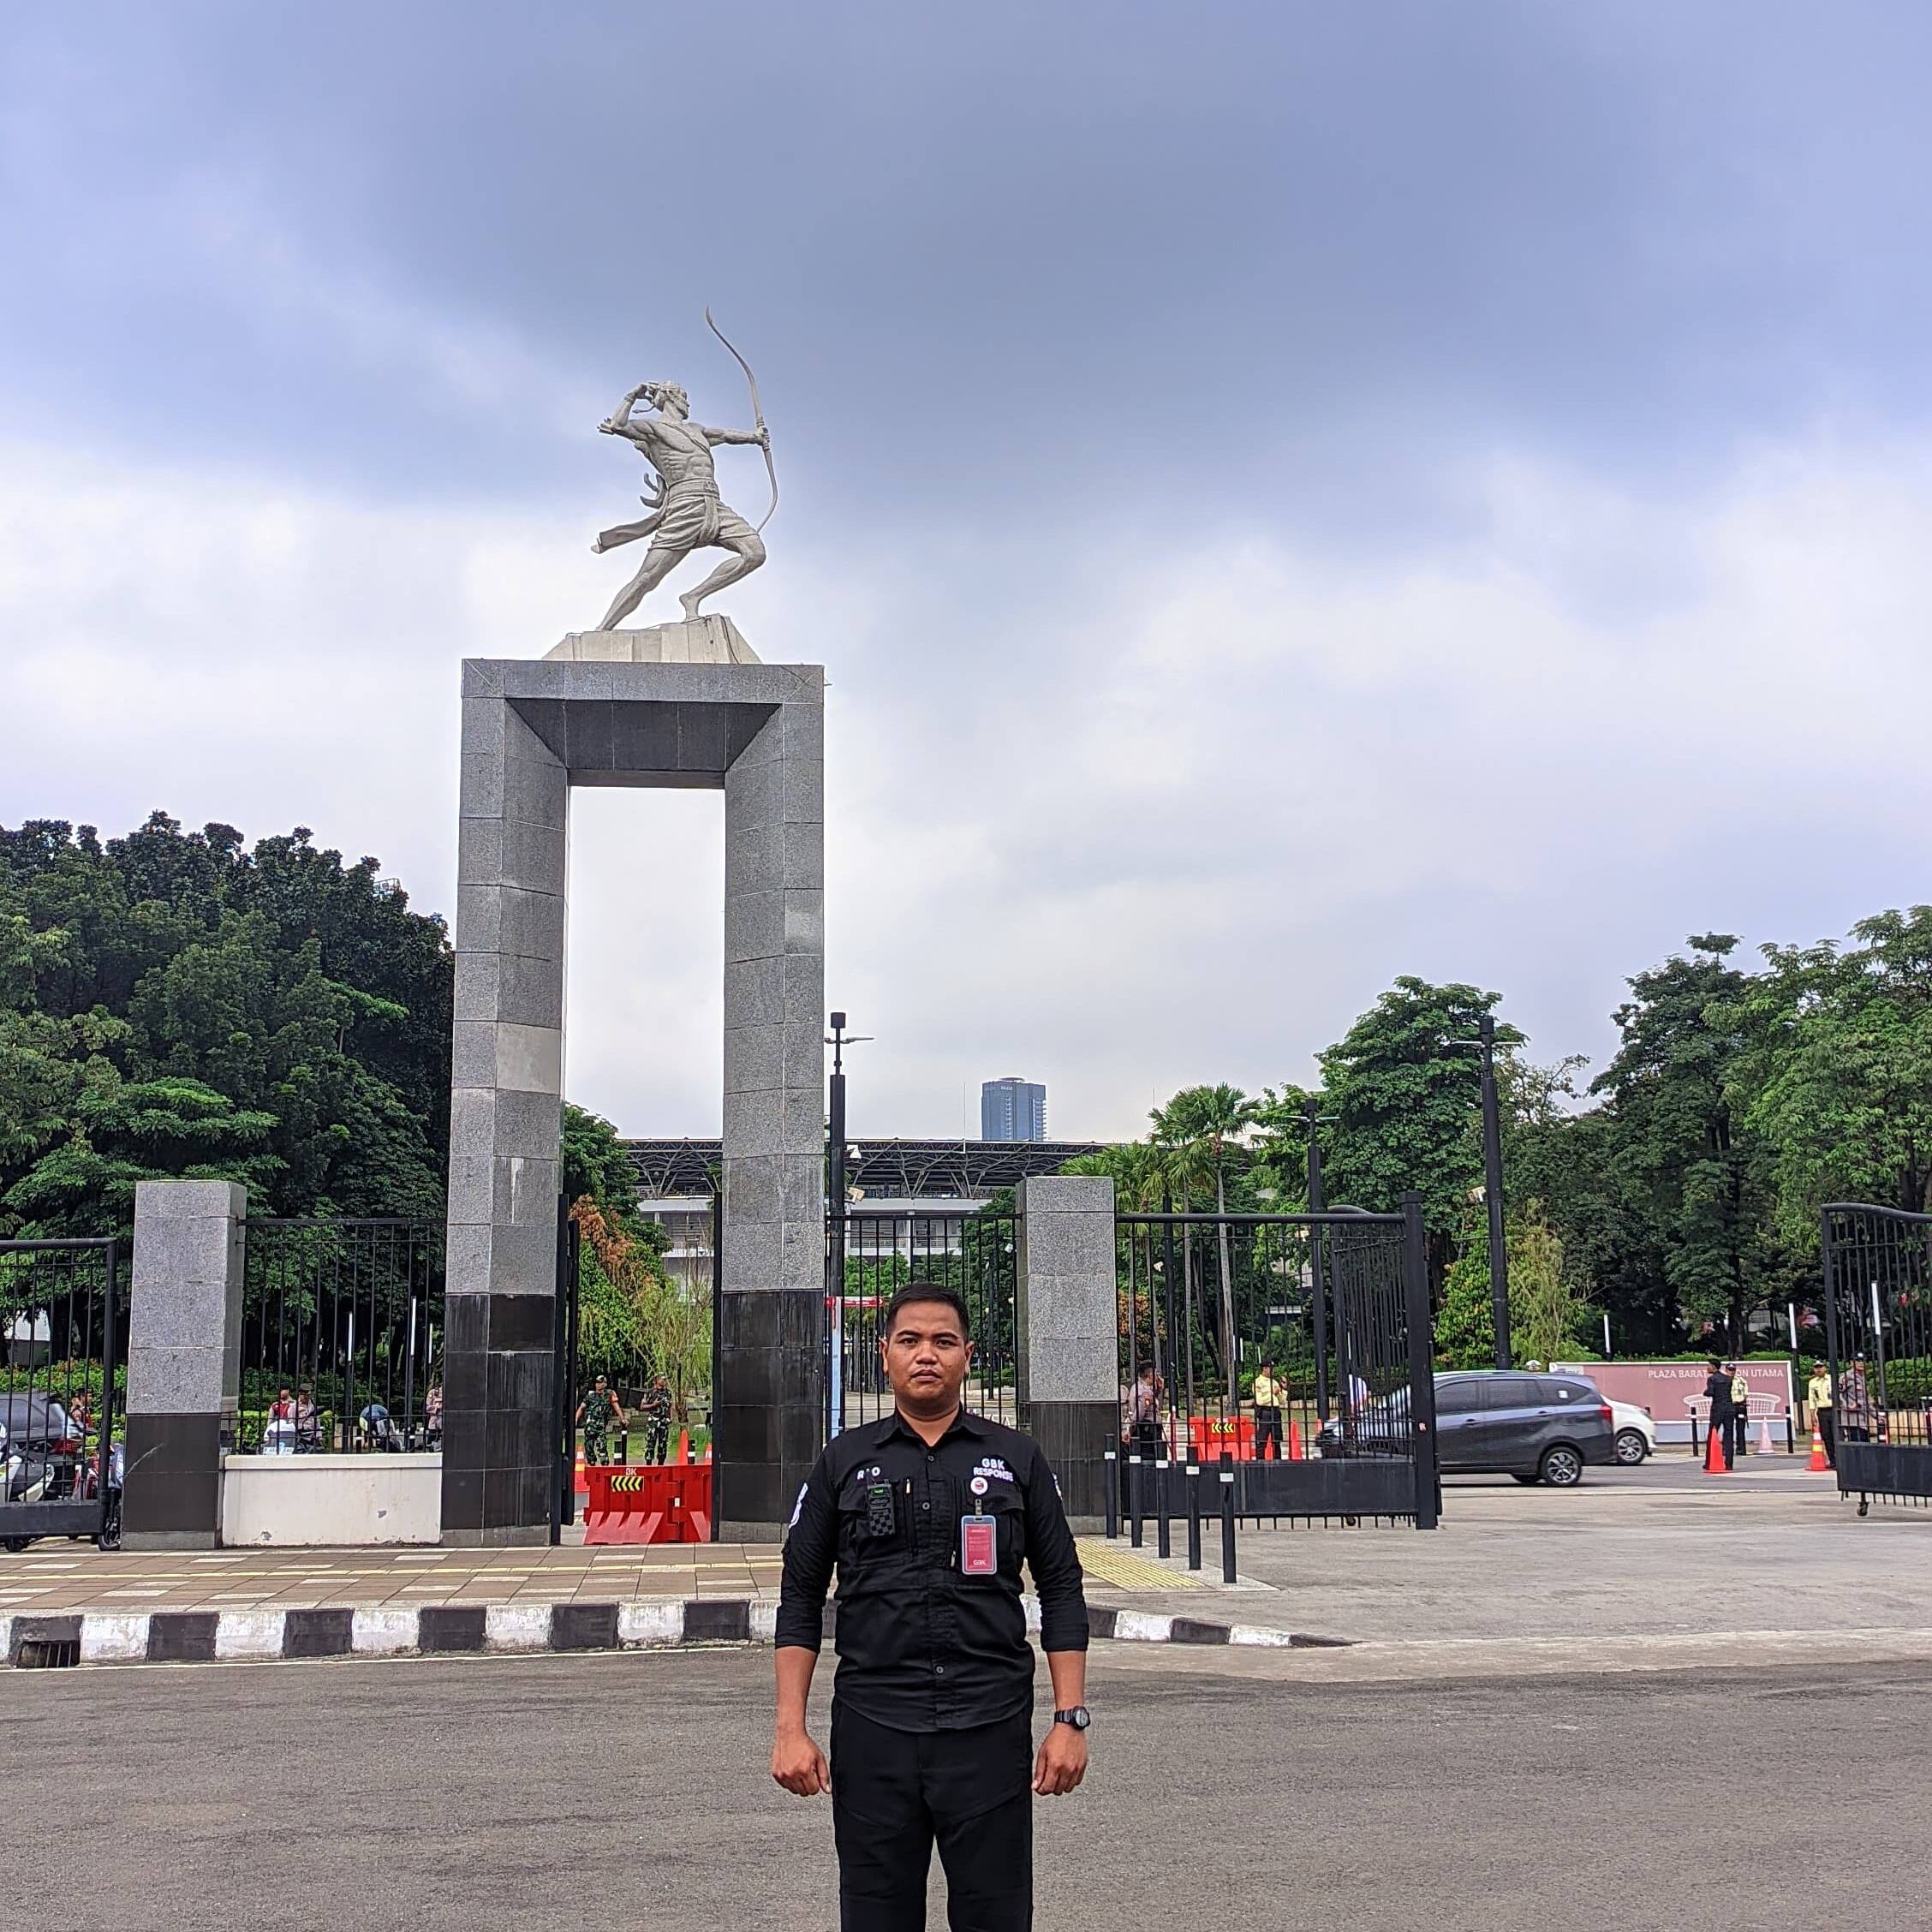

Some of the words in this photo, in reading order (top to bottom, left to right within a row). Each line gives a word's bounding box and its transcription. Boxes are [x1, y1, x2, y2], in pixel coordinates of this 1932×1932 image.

[1649, 1369, 1677, 1378] PLAZA
[1679, 1369, 1707, 1378] BARAT
[1750, 1368, 1784, 1378] UTAMA
[981, 1458, 1005, 1470] GBK
[856, 1466, 880, 1480] RO
[973, 1466, 1014, 1482] RESPONSE
